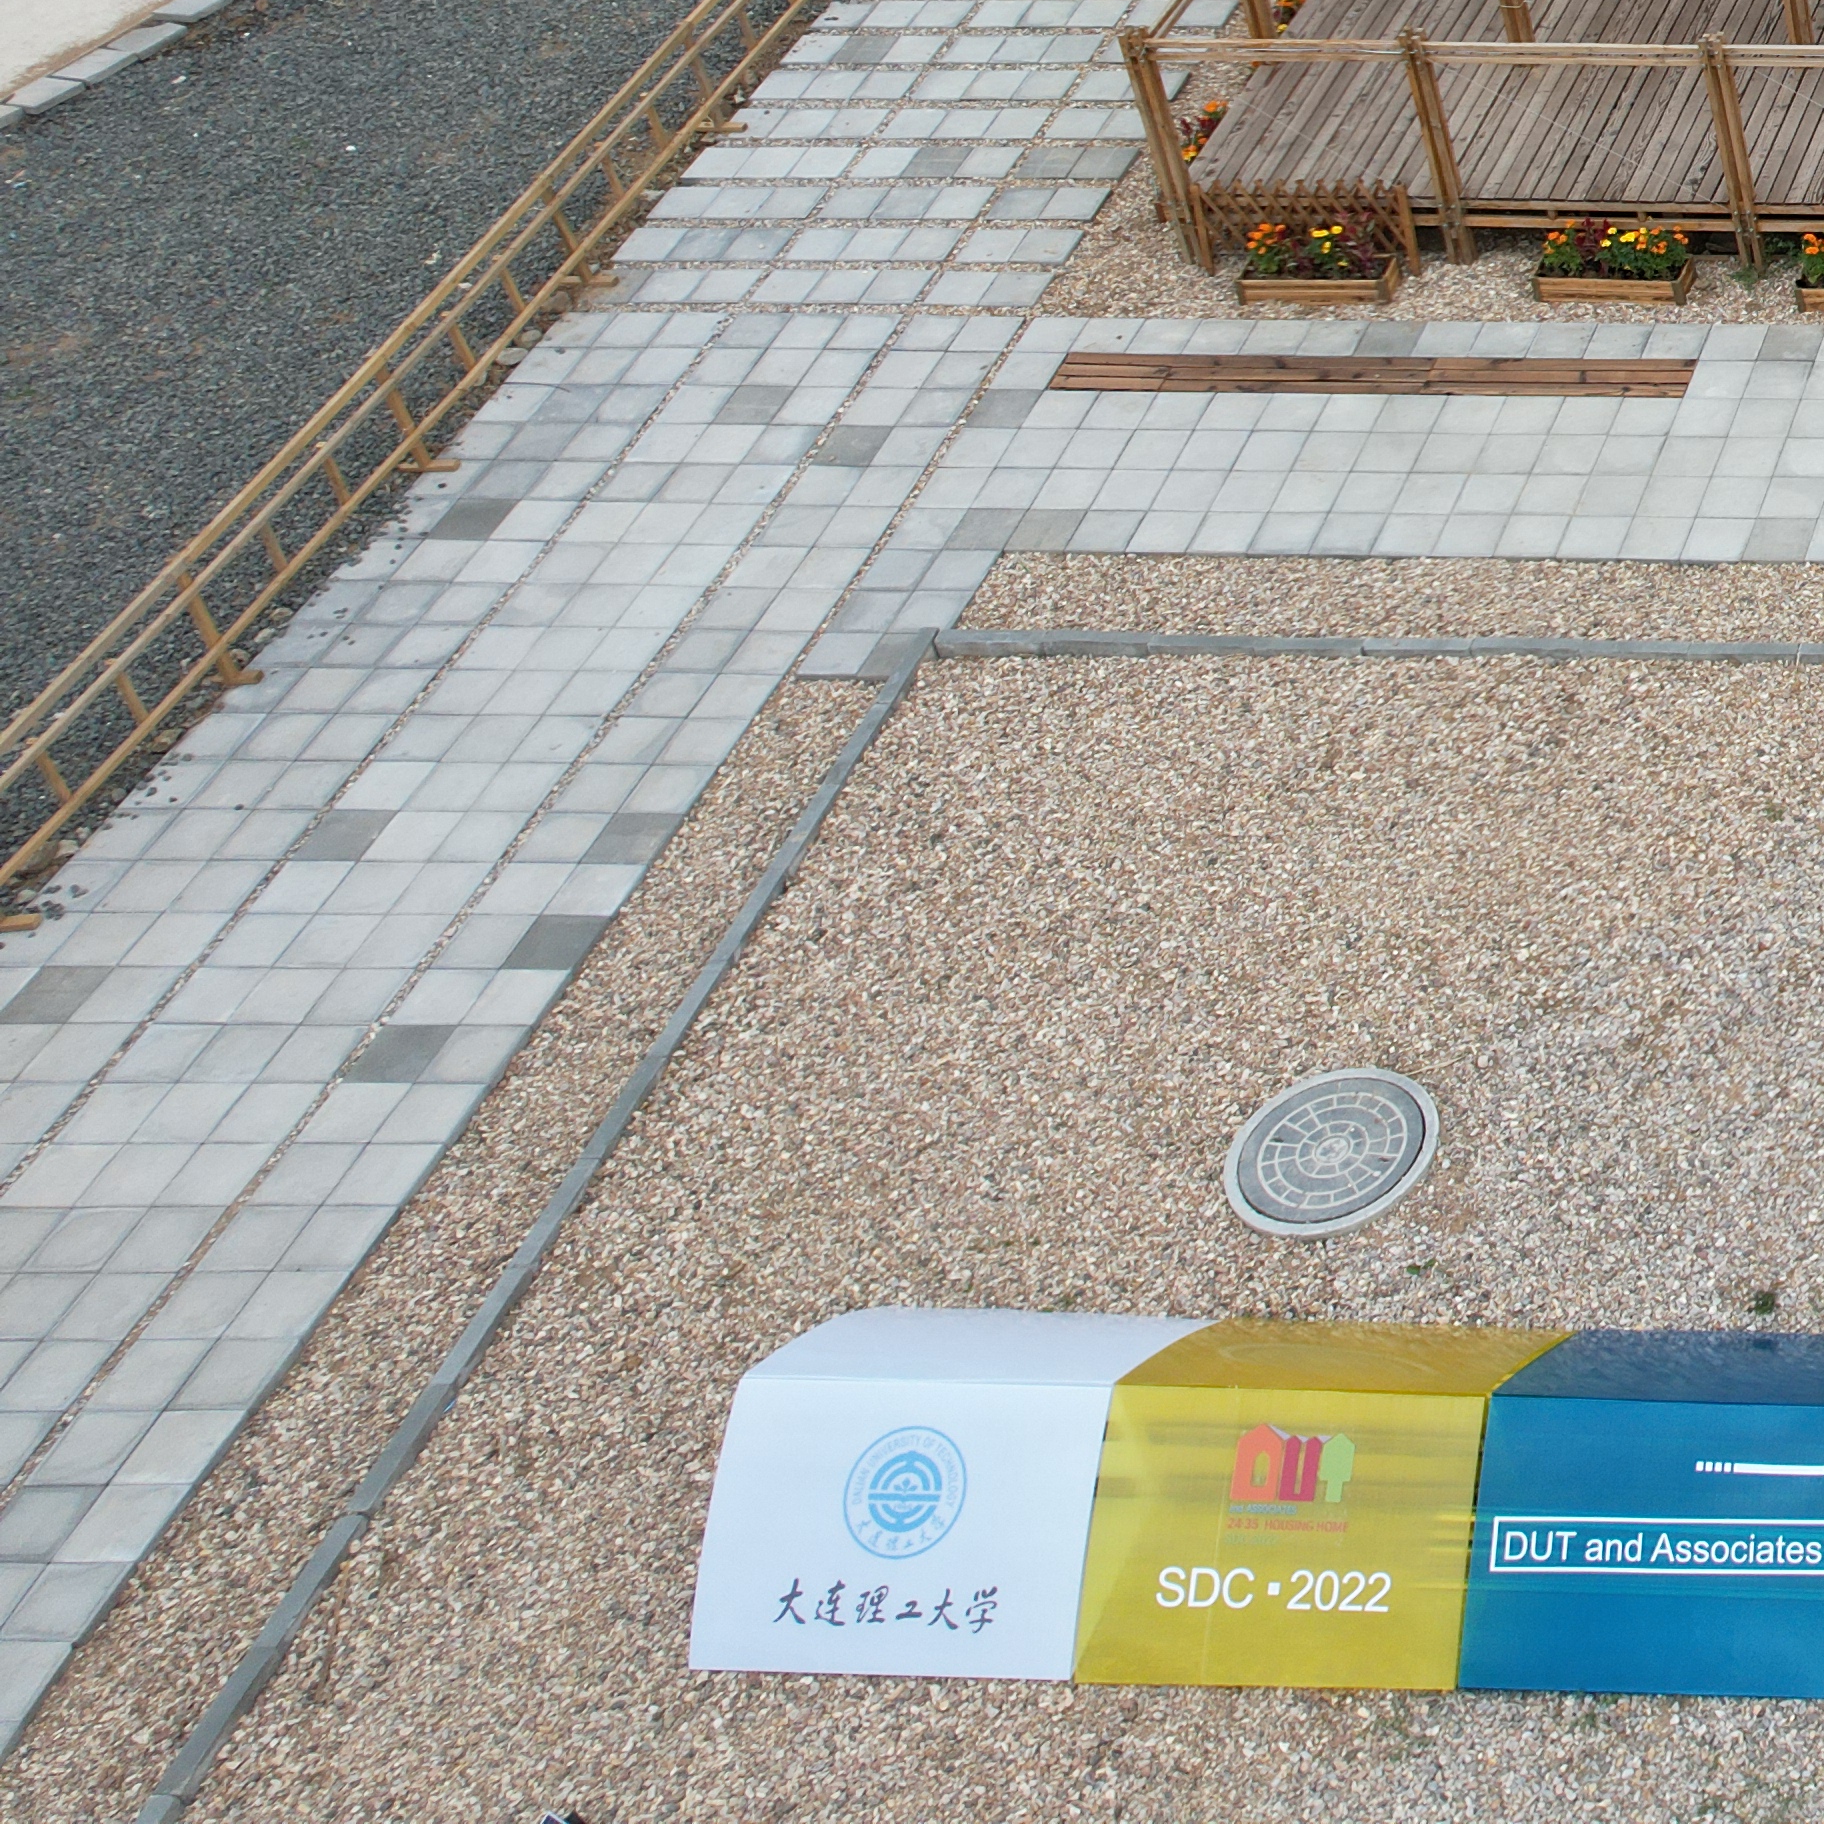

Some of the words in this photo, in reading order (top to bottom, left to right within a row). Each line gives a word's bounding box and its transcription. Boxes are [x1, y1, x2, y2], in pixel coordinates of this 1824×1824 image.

[868, 1434, 921, 1468] UNIVERSITY
[937, 1444, 959, 1508] TECHNOLOGY
[1264, 1519, 1314, 1532] HOUSING
[1316, 1520, 1349, 1533] HOME
[1503, 1531, 1577, 1562] DUT
[1585, 1533, 1642, 1563] and
[1650, 1533, 1823, 1564] Associates
[772, 1577, 999, 1635] 大连理工大学
[1155, 1566, 1255, 1609] SDC
[1287, 1569, 1391, 1612] 2022
